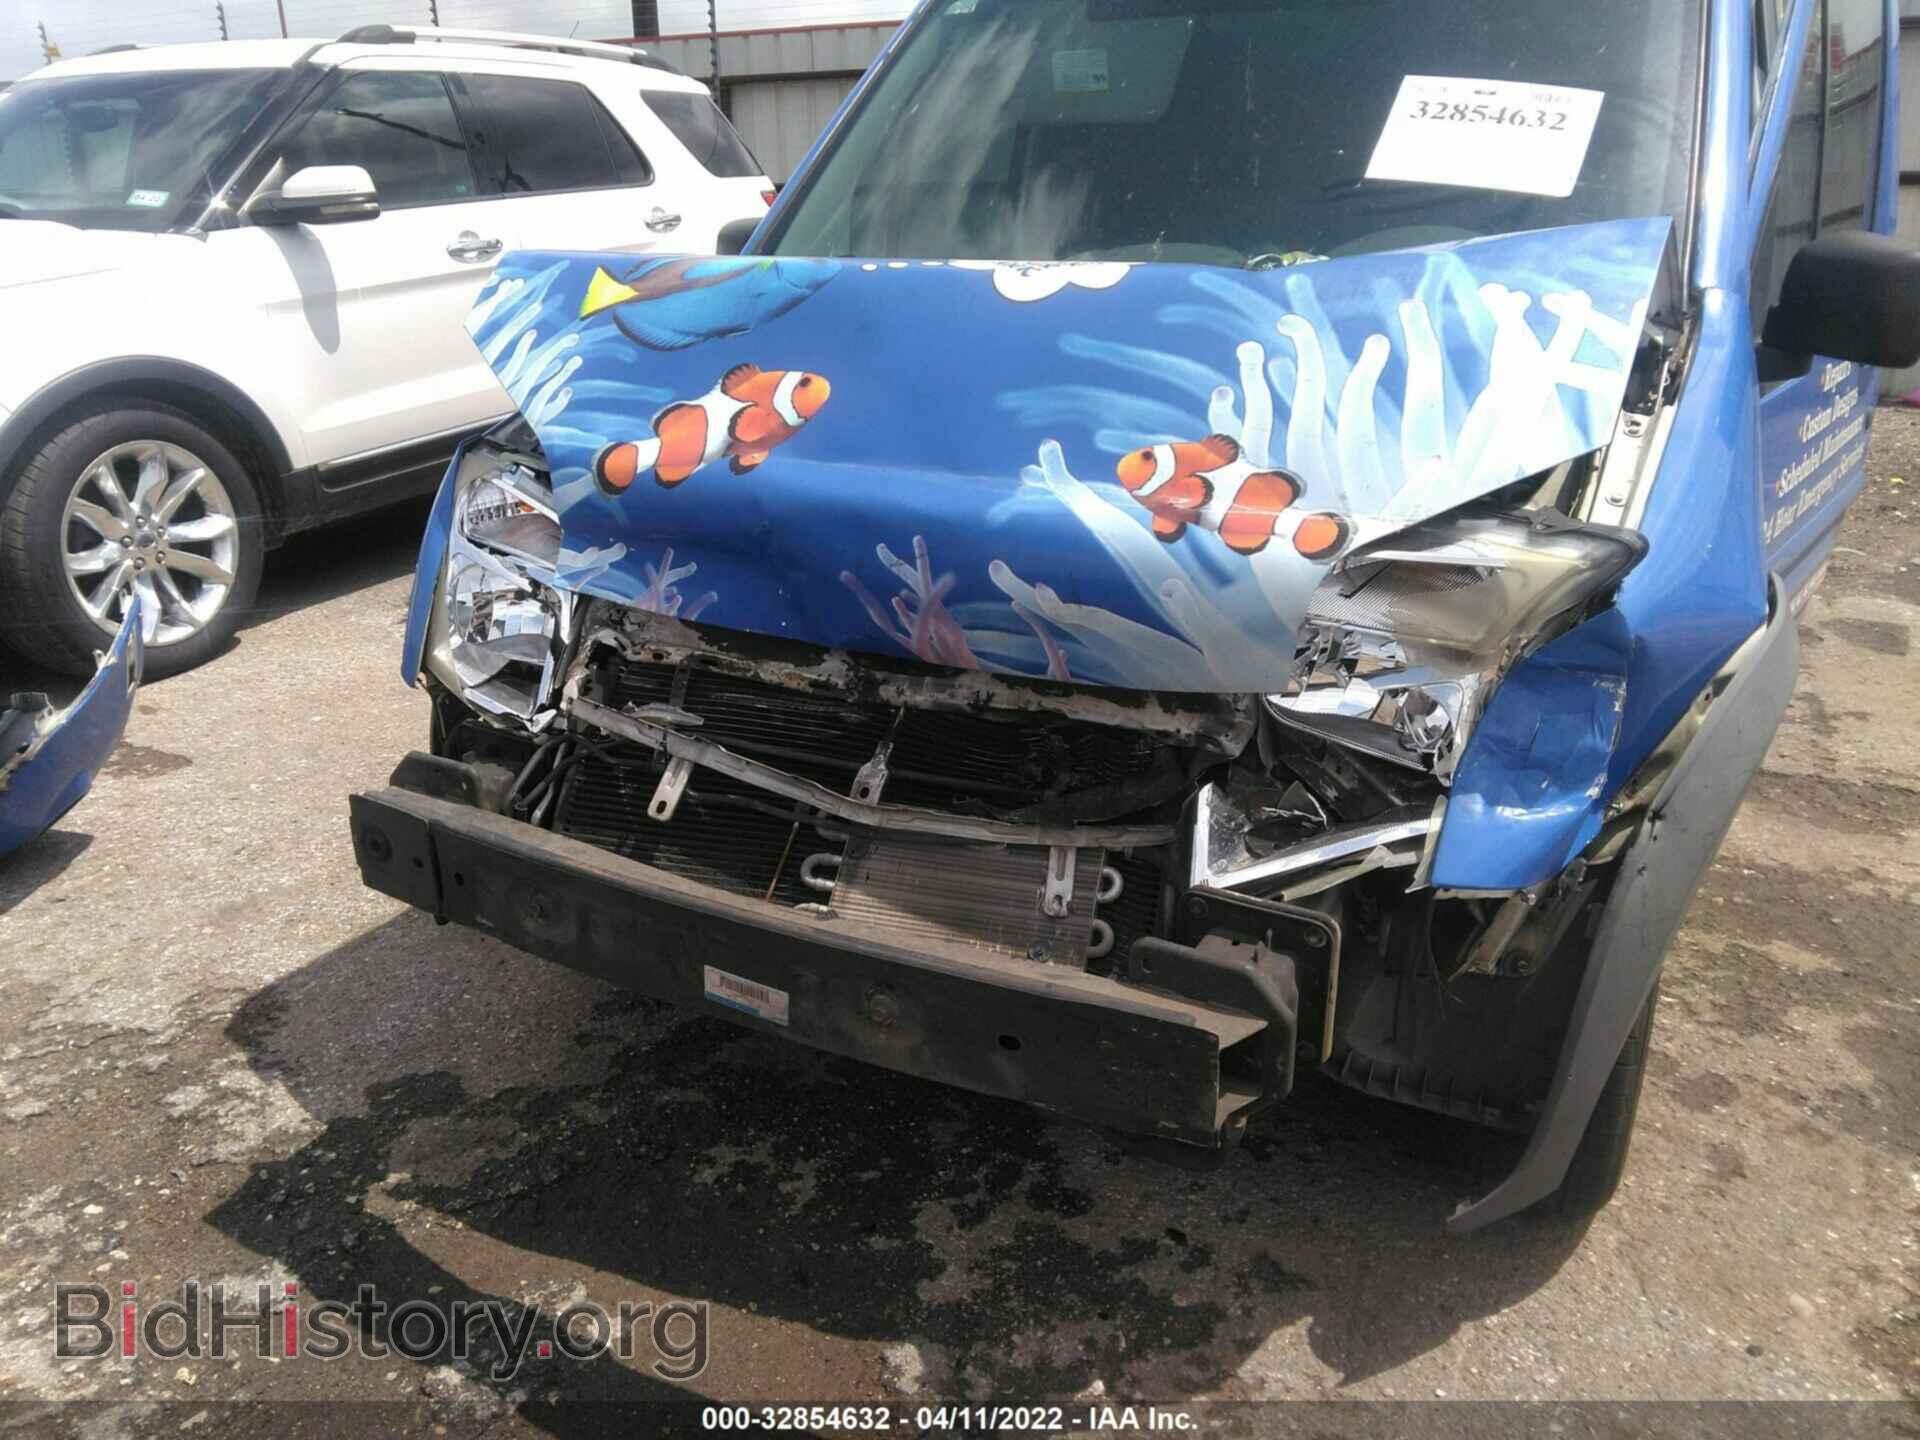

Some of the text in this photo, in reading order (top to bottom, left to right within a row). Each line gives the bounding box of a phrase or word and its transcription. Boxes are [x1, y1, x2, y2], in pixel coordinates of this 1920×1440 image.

[1409, 99, 1568, 132] 32854632
[1802, 406, 1833, 443] Custom
[1778, 440, 1824, 499] Scheduled
[1773, 503, 1798, 539] Hour
